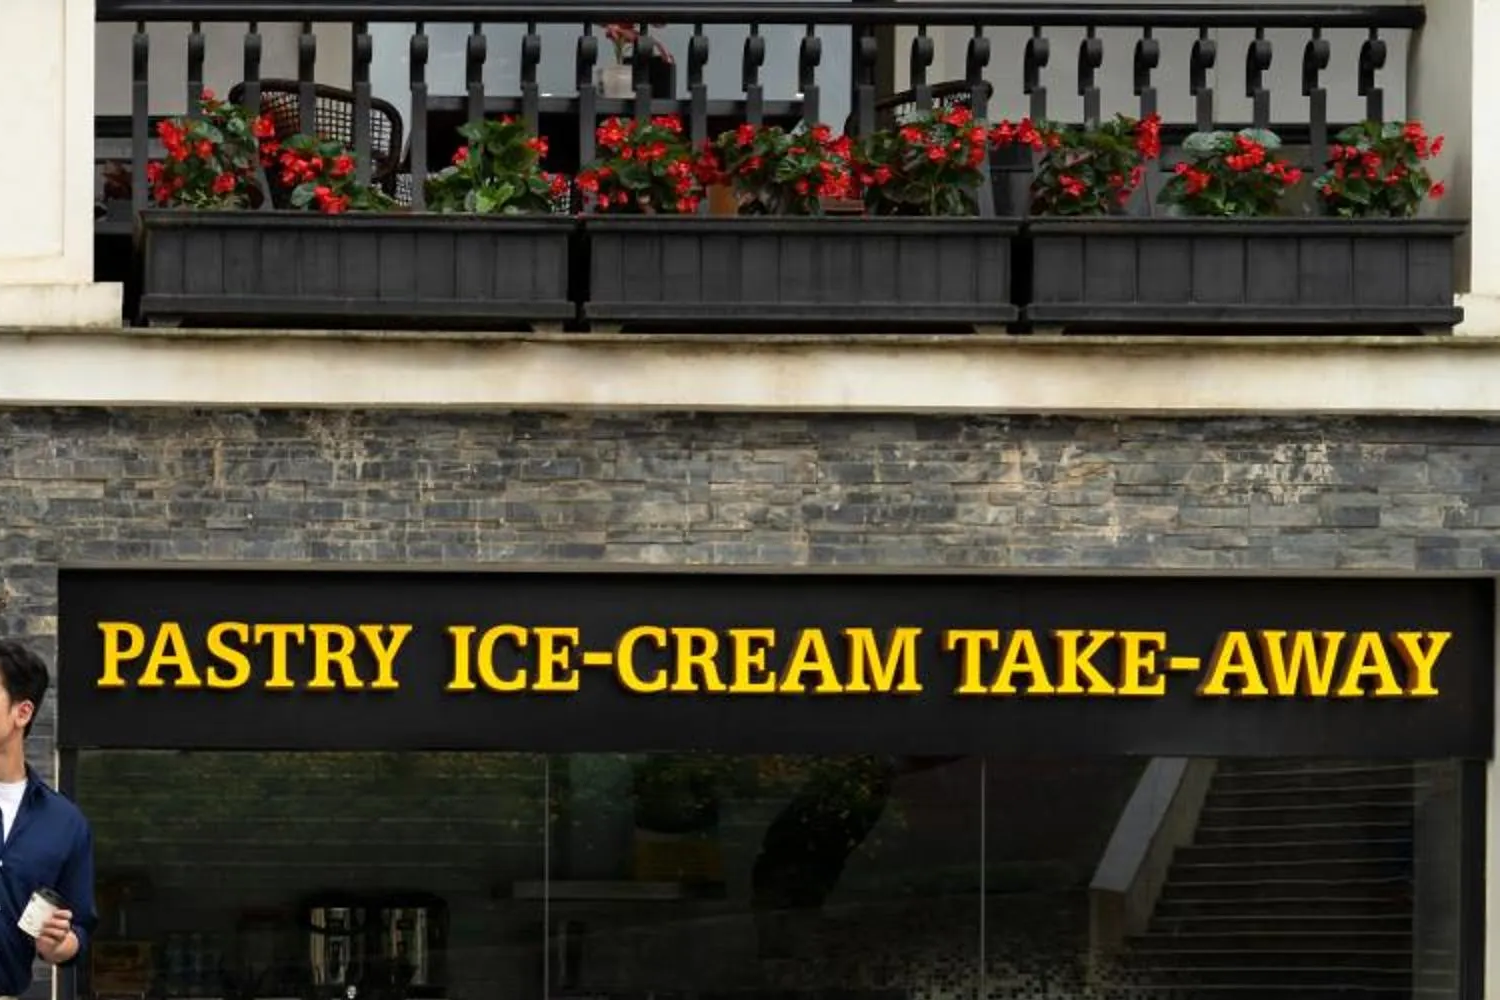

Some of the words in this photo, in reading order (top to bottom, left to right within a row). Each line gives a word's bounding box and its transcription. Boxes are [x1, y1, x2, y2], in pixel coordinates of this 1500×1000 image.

[97, 620, 414, 690] PASTRY
[447, 623, 923, 694] ICE-CREAM
[946, 628, 1453, 698] TAKE-AWAY
